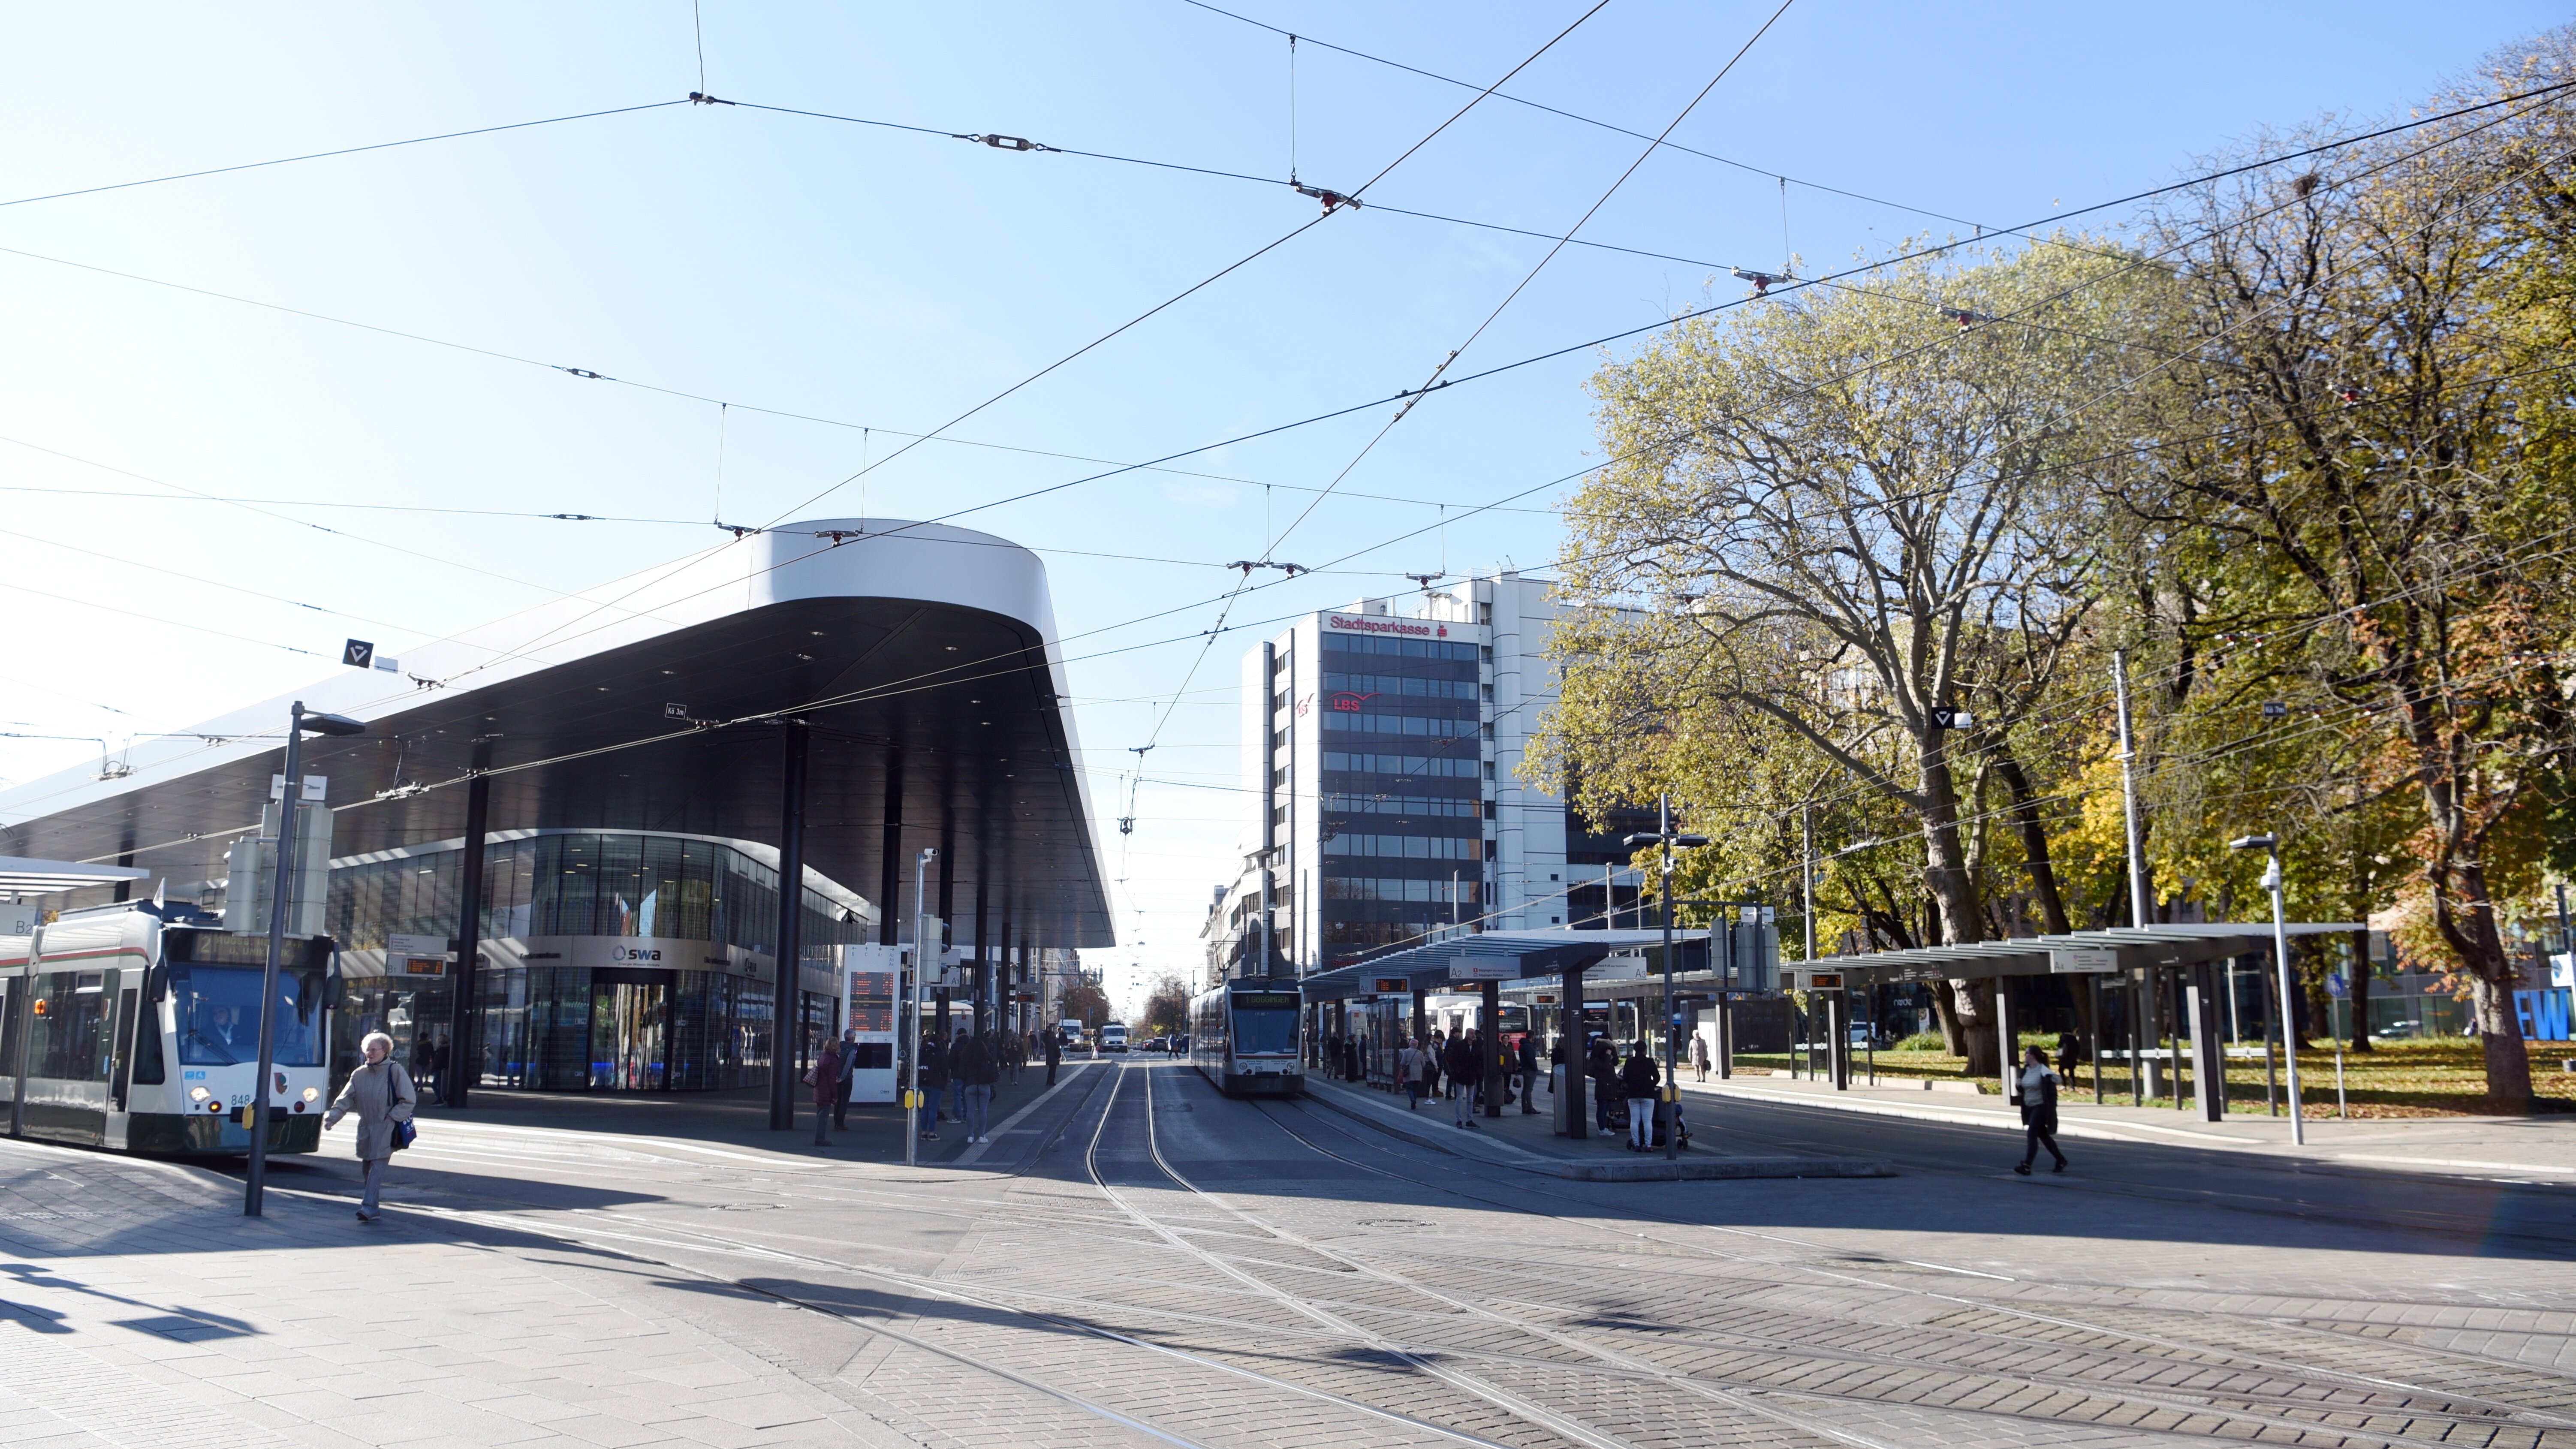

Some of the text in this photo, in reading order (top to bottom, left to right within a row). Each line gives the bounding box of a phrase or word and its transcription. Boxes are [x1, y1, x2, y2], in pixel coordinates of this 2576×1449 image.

[1331, 616, 1430, 635] Stadtsparkasse
[1334, 699, 1360, 711] LBS
[16, 920, 32, 934] B2
[201, 936, 211, 953] 2
[628, 949, 661, 961] swa
[1451, 968, 1462, 978] A2
[1635, 968, 1646, 978] A3
[951, 977, 959, 985] A1
[231, 1094, 250, 1106] 848
